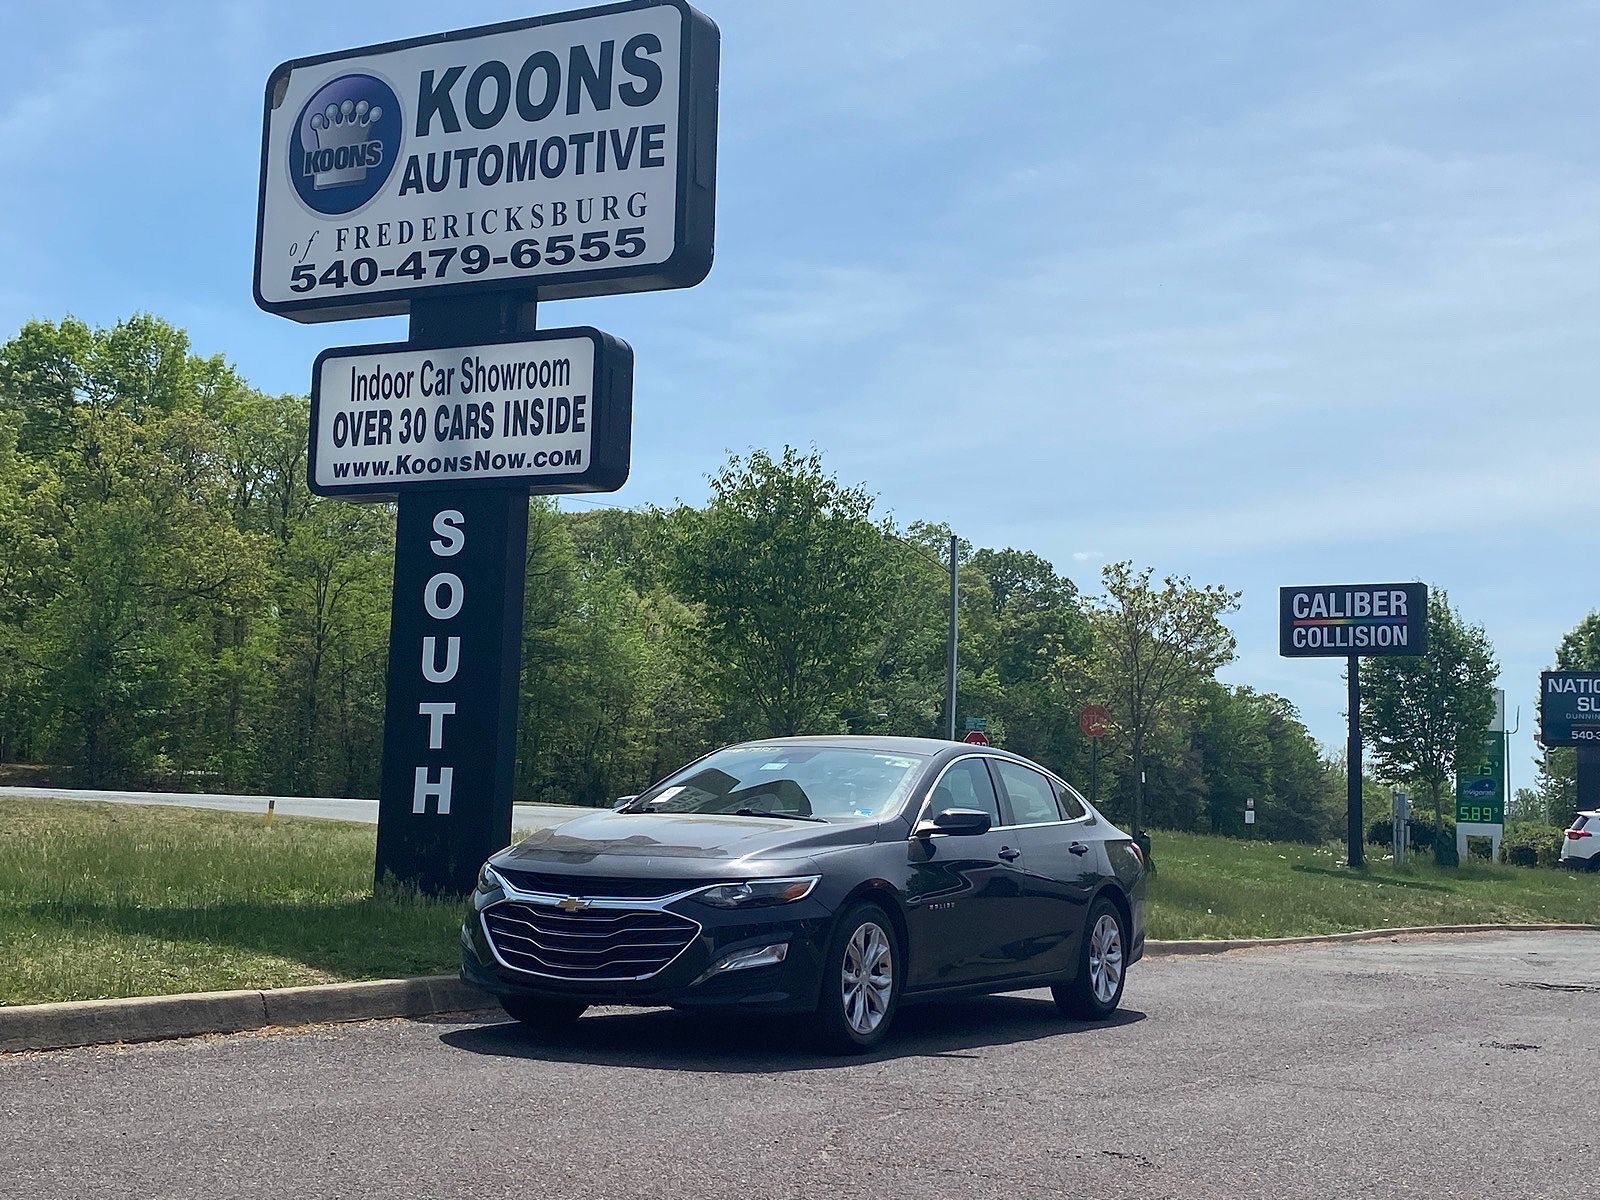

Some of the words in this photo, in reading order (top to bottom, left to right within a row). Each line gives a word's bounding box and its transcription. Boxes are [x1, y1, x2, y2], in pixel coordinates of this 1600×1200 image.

[415, 33, 663, 138] KOONS
[303, 139, 384, 177] KOONS
[398, 124, 666, 196] AUTOMOTIVE
[289, 230, 320, 262] of
[335, 191, 648, 251] FREDERICKSBURG
[289, 227, 647, 293] 540-479-6555
[351, 364, 415, 402] Indoor
[420, 359, 455, 397] Car
[460, 356, 570, 395] Showroom
[333, 409, 393, 448] OVER
[400, 407, 427, 444] 30
[434, 400, 495, 443] CARS
[503, 395, 586, 437] INSIDE
[1292, 590, 1408, 619] CALIBER
[412, 509, 465, 815] SOUTH
[1292, 625, 1408, 648] COLLISION
